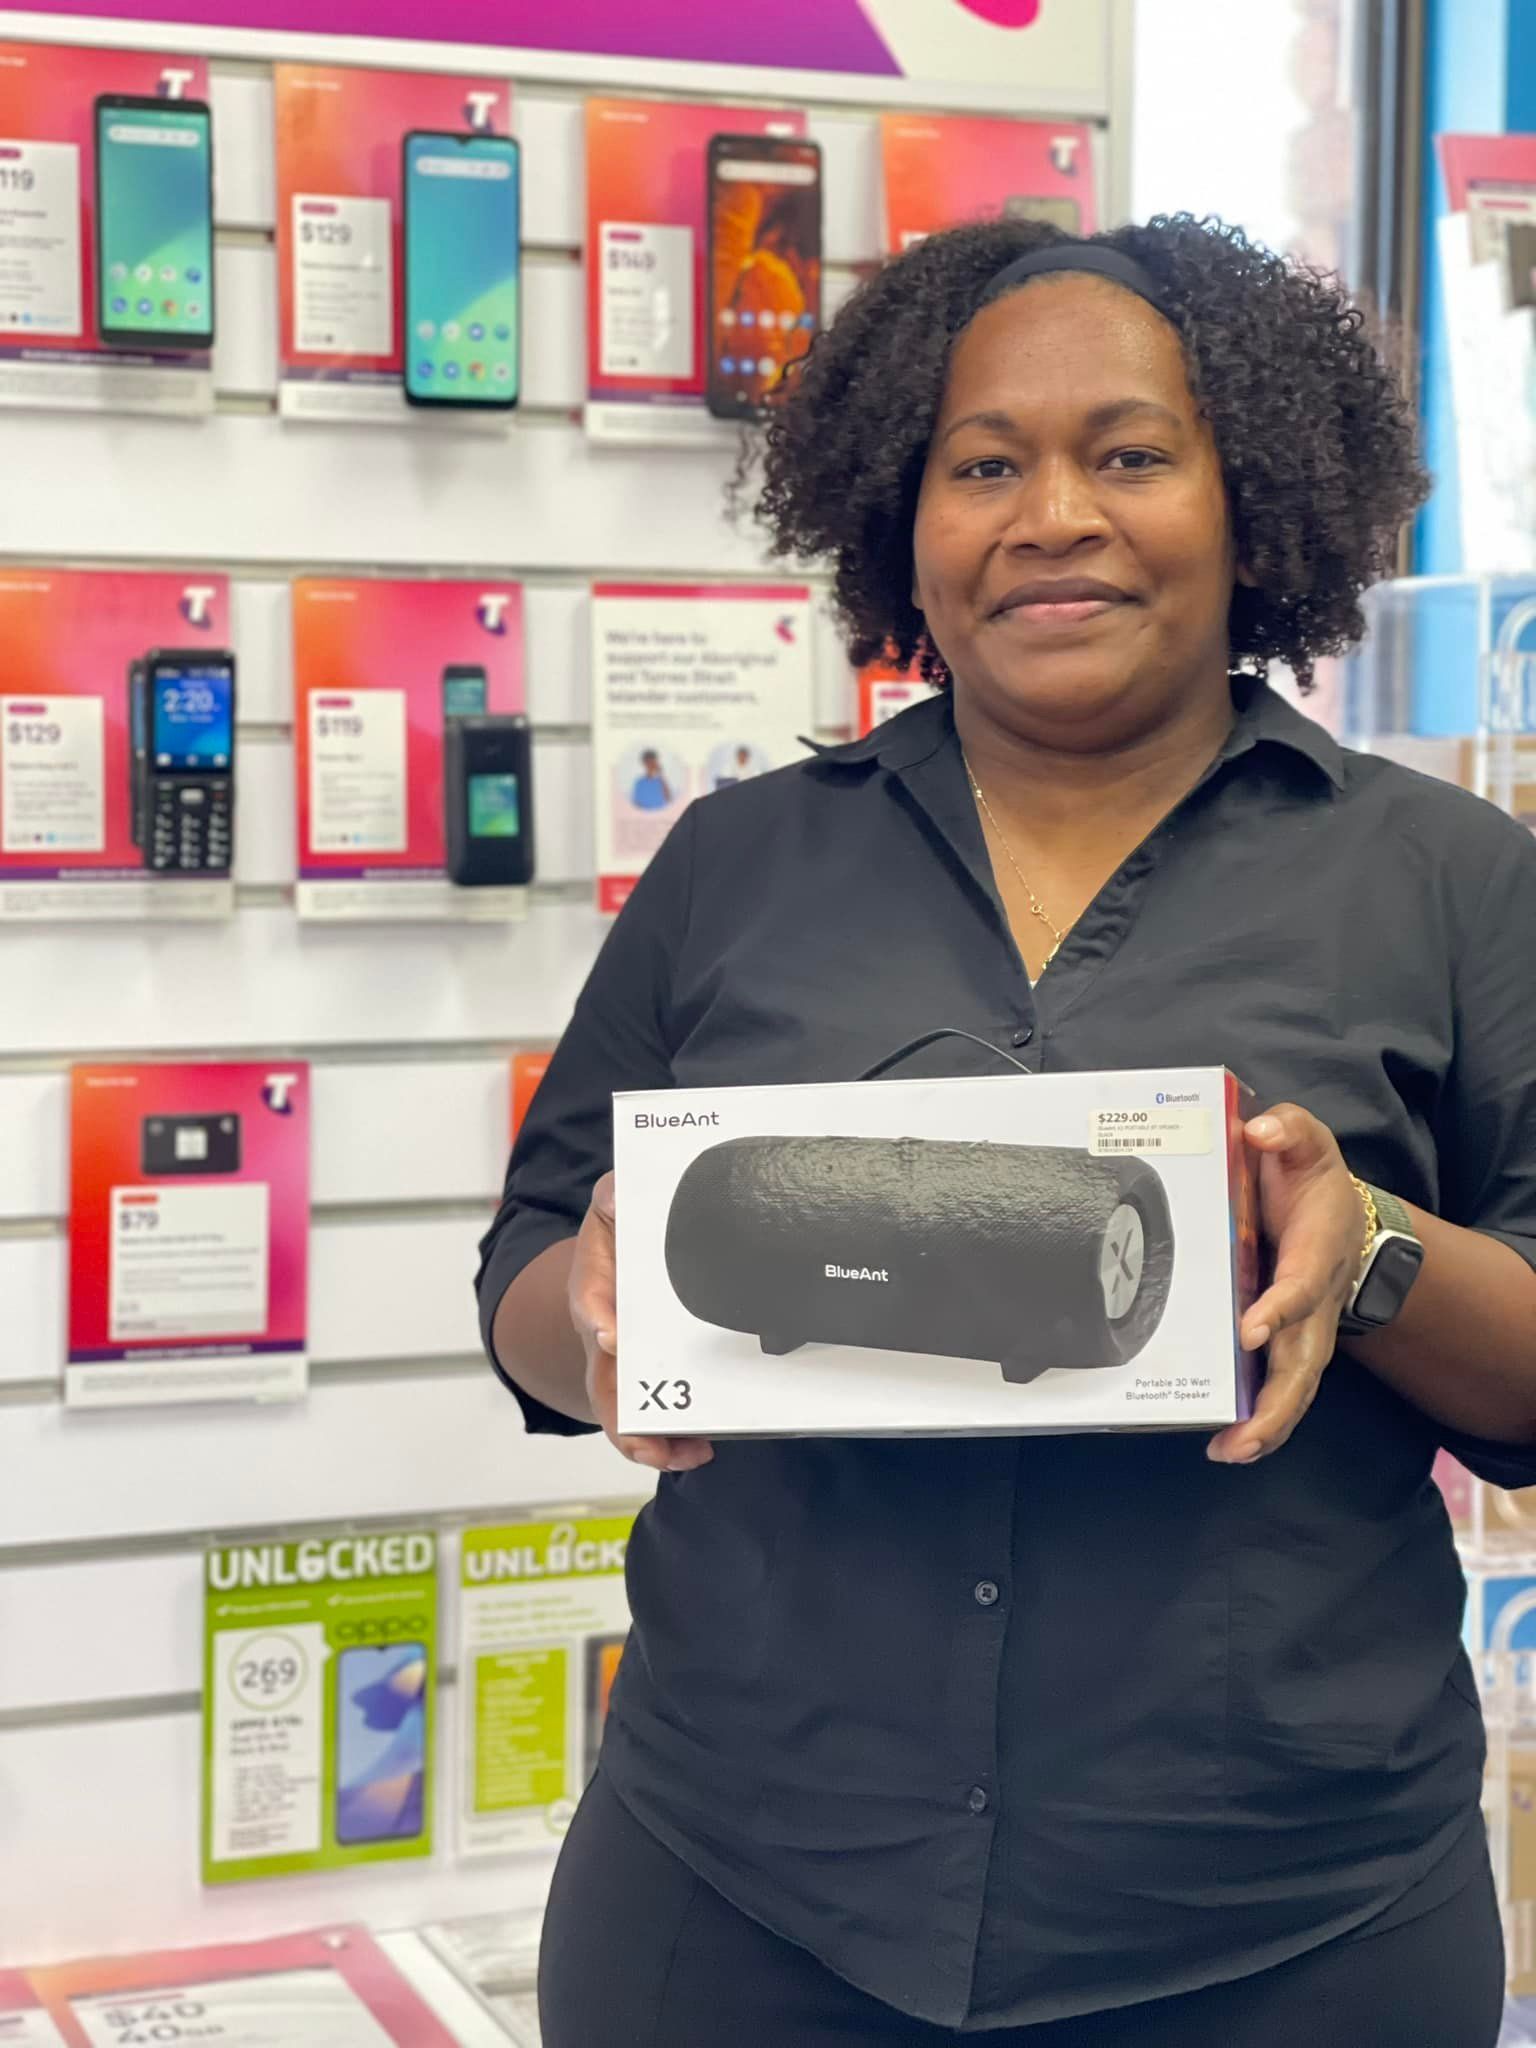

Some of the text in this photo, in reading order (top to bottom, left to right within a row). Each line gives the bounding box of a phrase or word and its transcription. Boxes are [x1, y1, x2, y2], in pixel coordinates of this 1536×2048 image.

[8, 722, 62, 745] $129
[1165, 1094, 1200, 1103] Bluetooth
[634, 1111, 720, 1129] BlueAnt
[1098, 1112, 1148, 1124] $229.00
[120, 1210, 160, 1231] $79
[825, 1264, 889, 1282] BlueAnt
[1135, 1377, 1211, 1388] Portable 30 Watt
[638, 1379, 692, 1411] X3
[1174, 1390, 1210, 1401] Speaker
